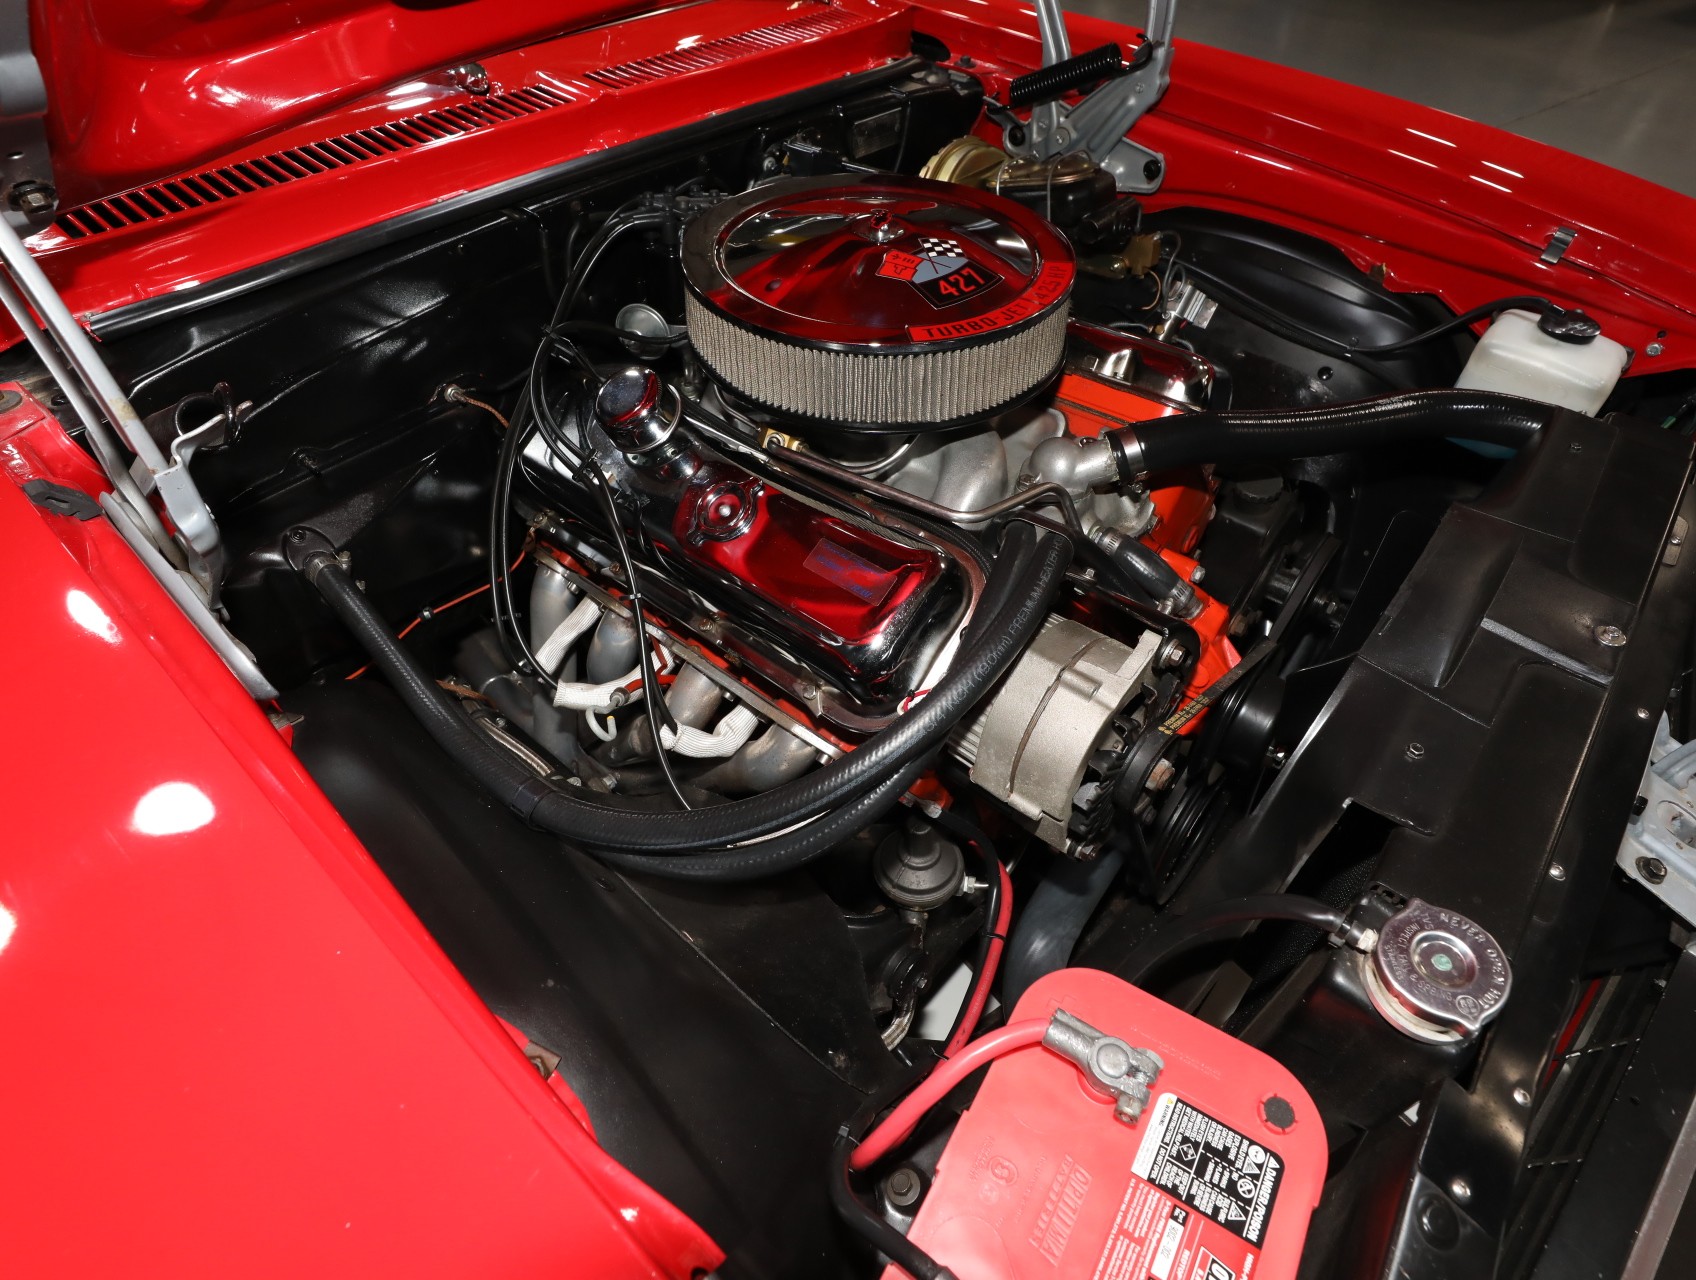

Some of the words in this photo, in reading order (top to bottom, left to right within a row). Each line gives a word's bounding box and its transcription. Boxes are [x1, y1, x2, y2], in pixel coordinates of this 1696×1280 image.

[938, 267, 986, 297] 427
[1047, 265, 1068, 279] HP
[1034, 280, 1062, 300] 425
[922, 303, 1030, 338] TURBO-JET
[1396, 922, 1421, 949] INSPECT
[1440, 912, 1486, 943] NEVER
[1486, 948, 1505, 986] OPEN
[1478, 987, 1502, 1010] HOT
[1211, 1165, 1223, 1185] FLAMES
[1218, 1169, 1230, 1189] SPARKS
[1230, 1170, 1239, 1181] NO
[1030, 1157, 1071, 1244] BATTERIES
[1040, 1167, 1092, 1260] OPTIMA
[1246, 1166, 1276, 1242] DANGER/POISON
[1174, 1248, 1190, 1279] REDTOP
